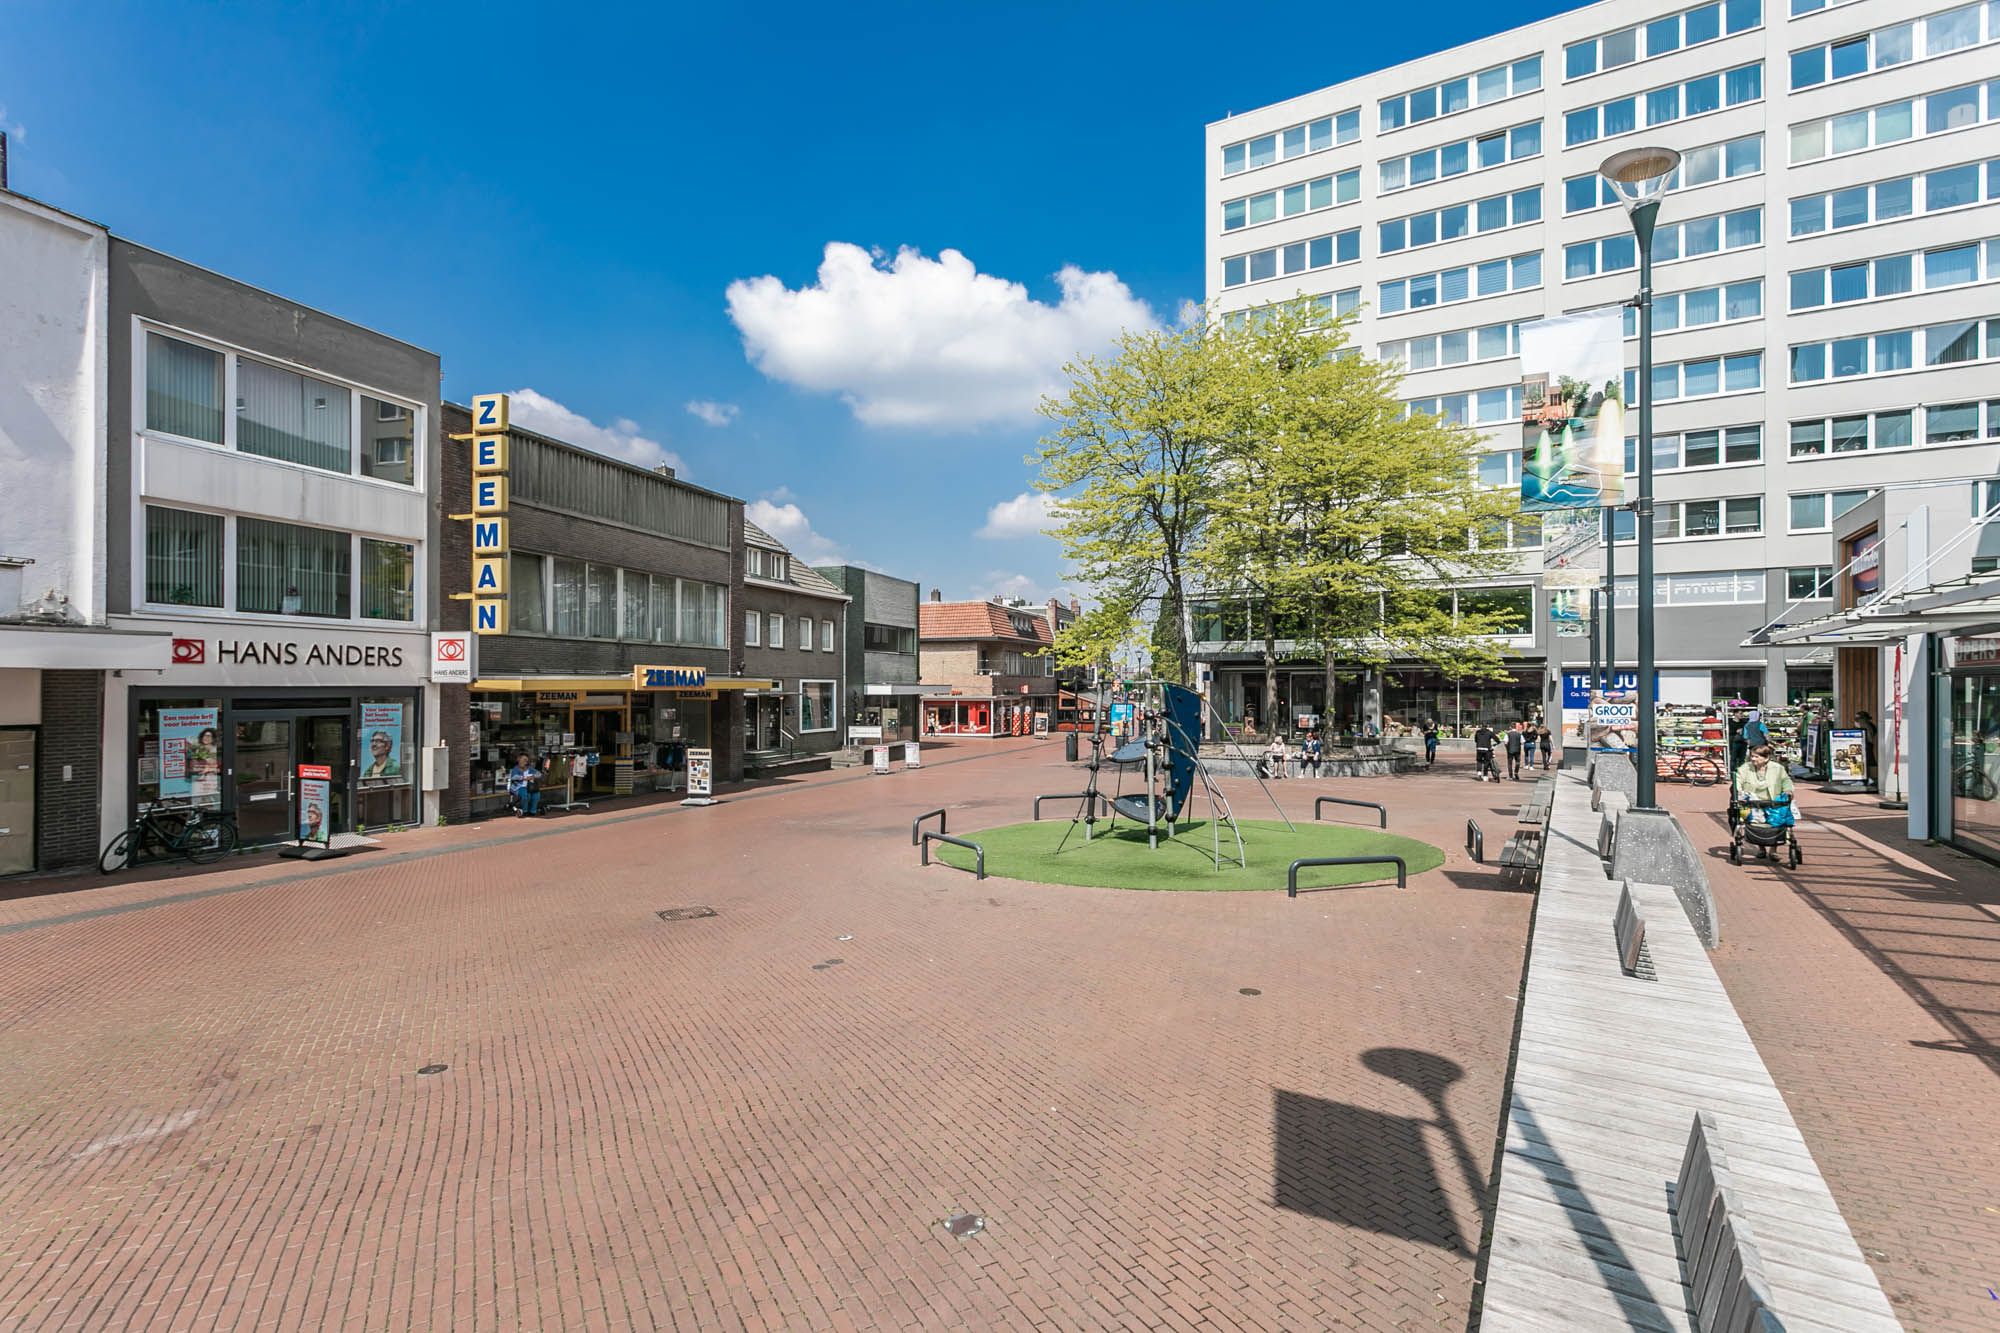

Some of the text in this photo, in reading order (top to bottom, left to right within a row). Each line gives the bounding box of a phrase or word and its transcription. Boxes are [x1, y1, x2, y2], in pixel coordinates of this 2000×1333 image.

[475, 400, 499, 629] ZEEMAN
[1674, 580, 1757, 594] FITNESS
[217, 640, 403, 668] HANS ANDERS
[645, 669, 706, 687] ZEEMAN
[1569, 675, 1591, 689] TE
[539, 692, 578, 701] ZEEMAN
[1595, 705, 1634, 716] GROOT
